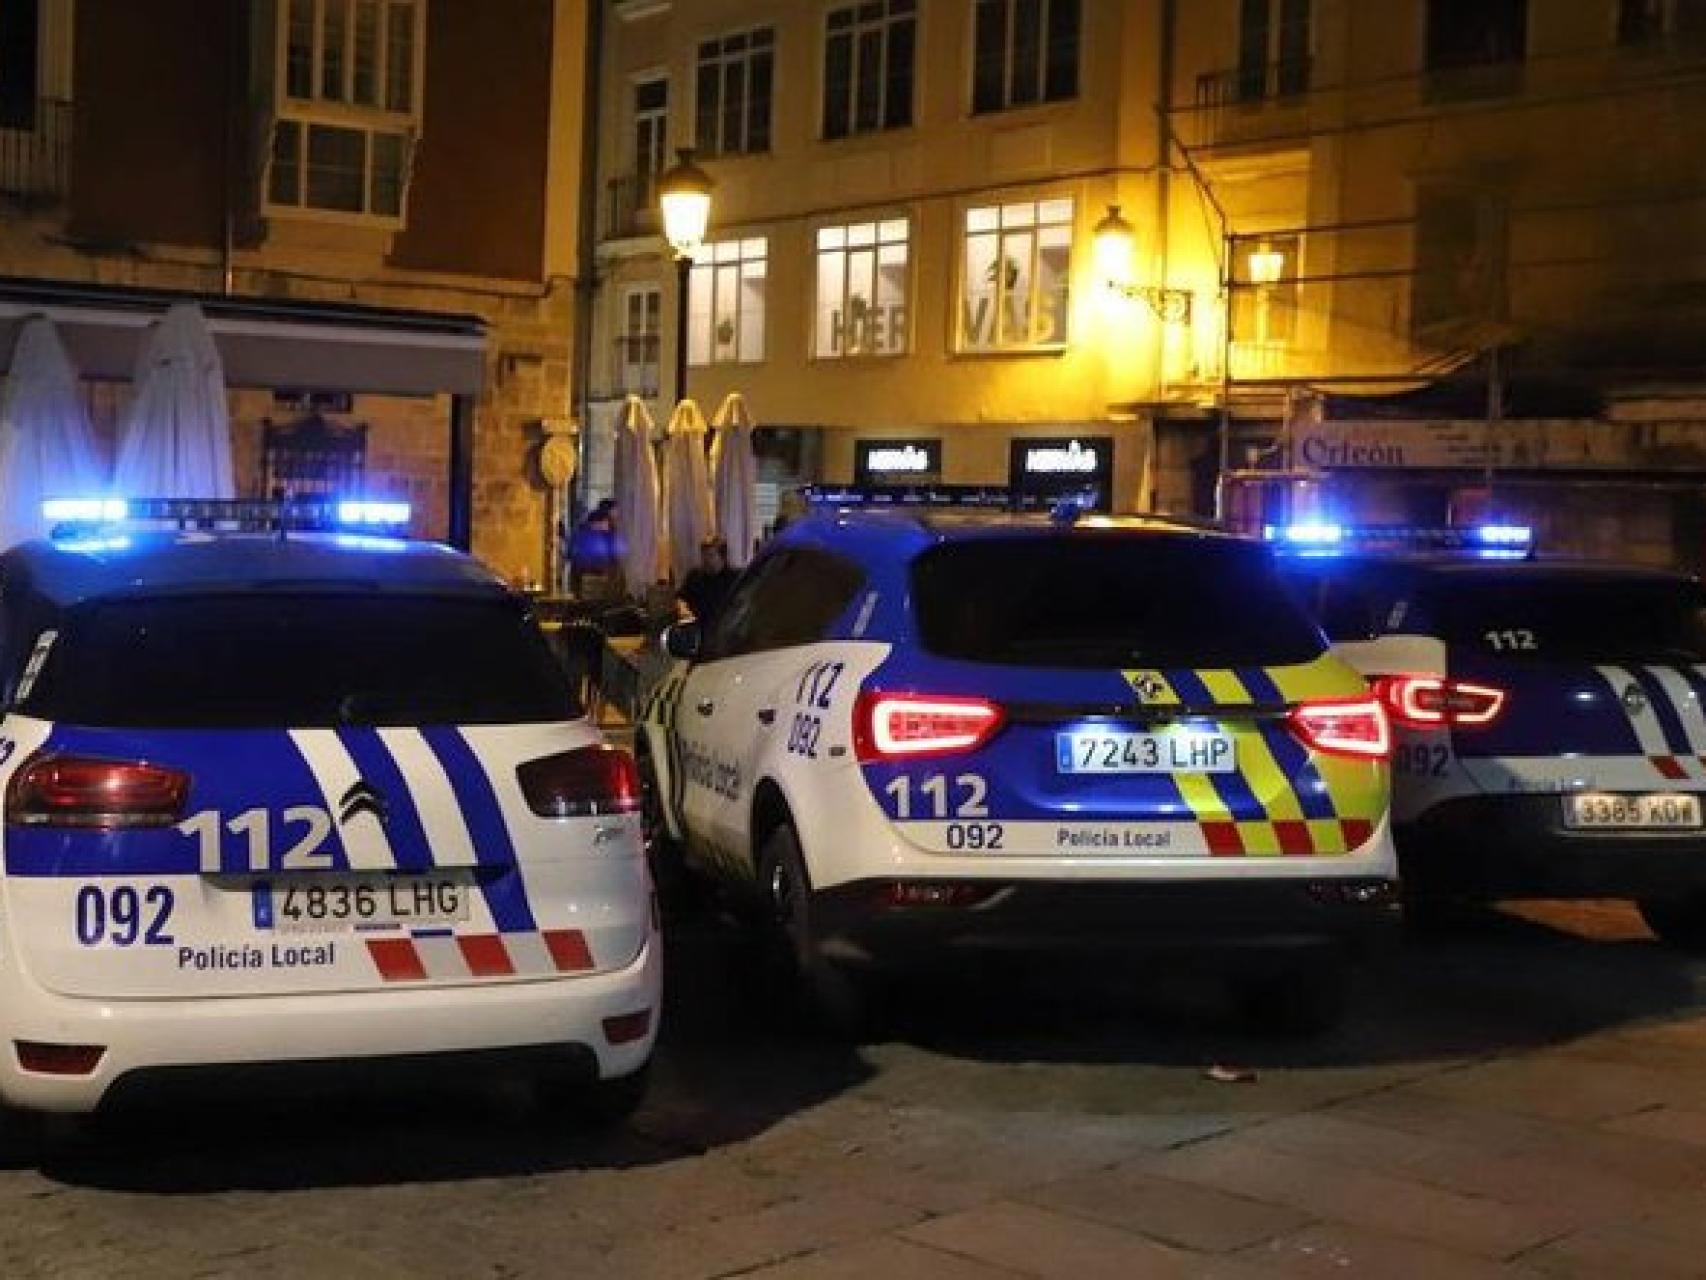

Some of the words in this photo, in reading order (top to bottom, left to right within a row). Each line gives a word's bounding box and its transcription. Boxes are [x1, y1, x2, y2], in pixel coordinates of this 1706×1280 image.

[1485, 630, 1537, 651] 112
[1079, 737, 1160, 768] 7243
[1169, 739, 1229, 767] LHP
[885, 774, 989, 819] 112
[178, 806, 335, 873] 112
[946, 824, 1003, 850] 092
[1124, 829, 1171, 846] Local
[76, 886, 174, 946] 092
[281, 884, 376, 921] 4836
[390, 881, 460, 917] LHG
[178, 944, 263, 971] Policía
[271, 941, 335, 967] Local
